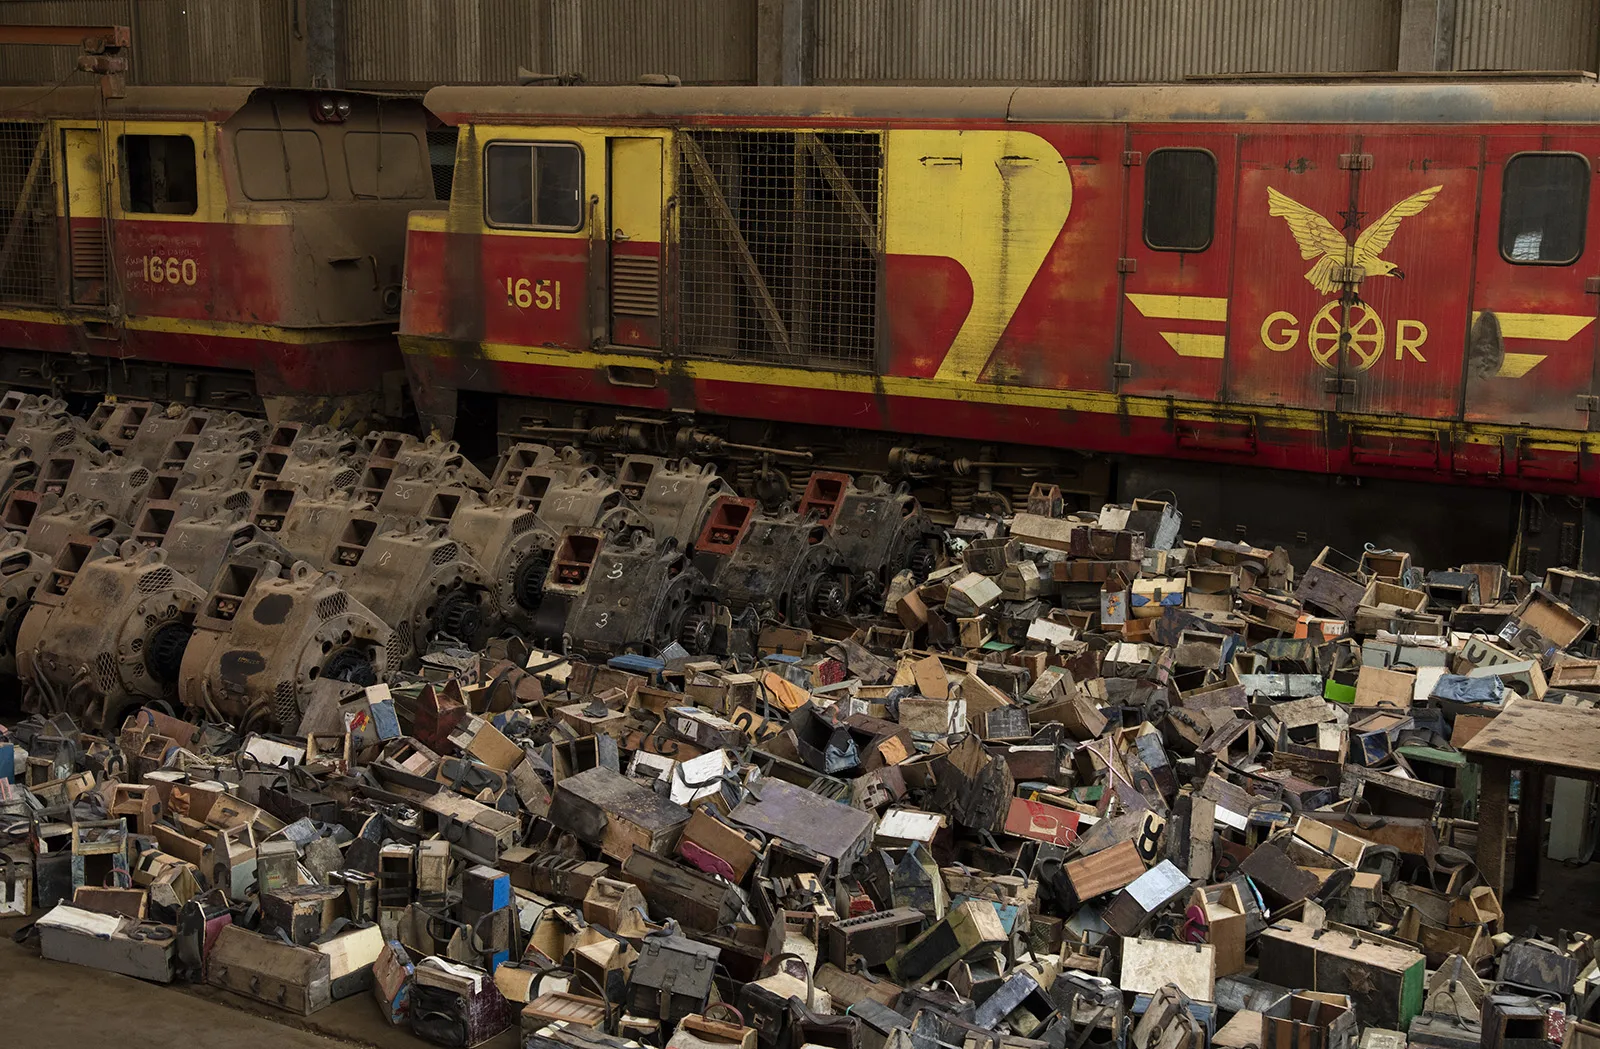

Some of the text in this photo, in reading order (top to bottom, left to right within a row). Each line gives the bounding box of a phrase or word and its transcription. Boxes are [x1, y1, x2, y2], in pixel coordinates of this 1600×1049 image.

[143, 255, 197, 286] 1660
[507, 277, 561, 310] 1651
[1260, 310, 1428, 363] G R
[17, 433, 31, 444] 22
[395, 484, 413, 499] 26
[607, 562, 624, 580] 3
[594, 612, 609, 629] 3
